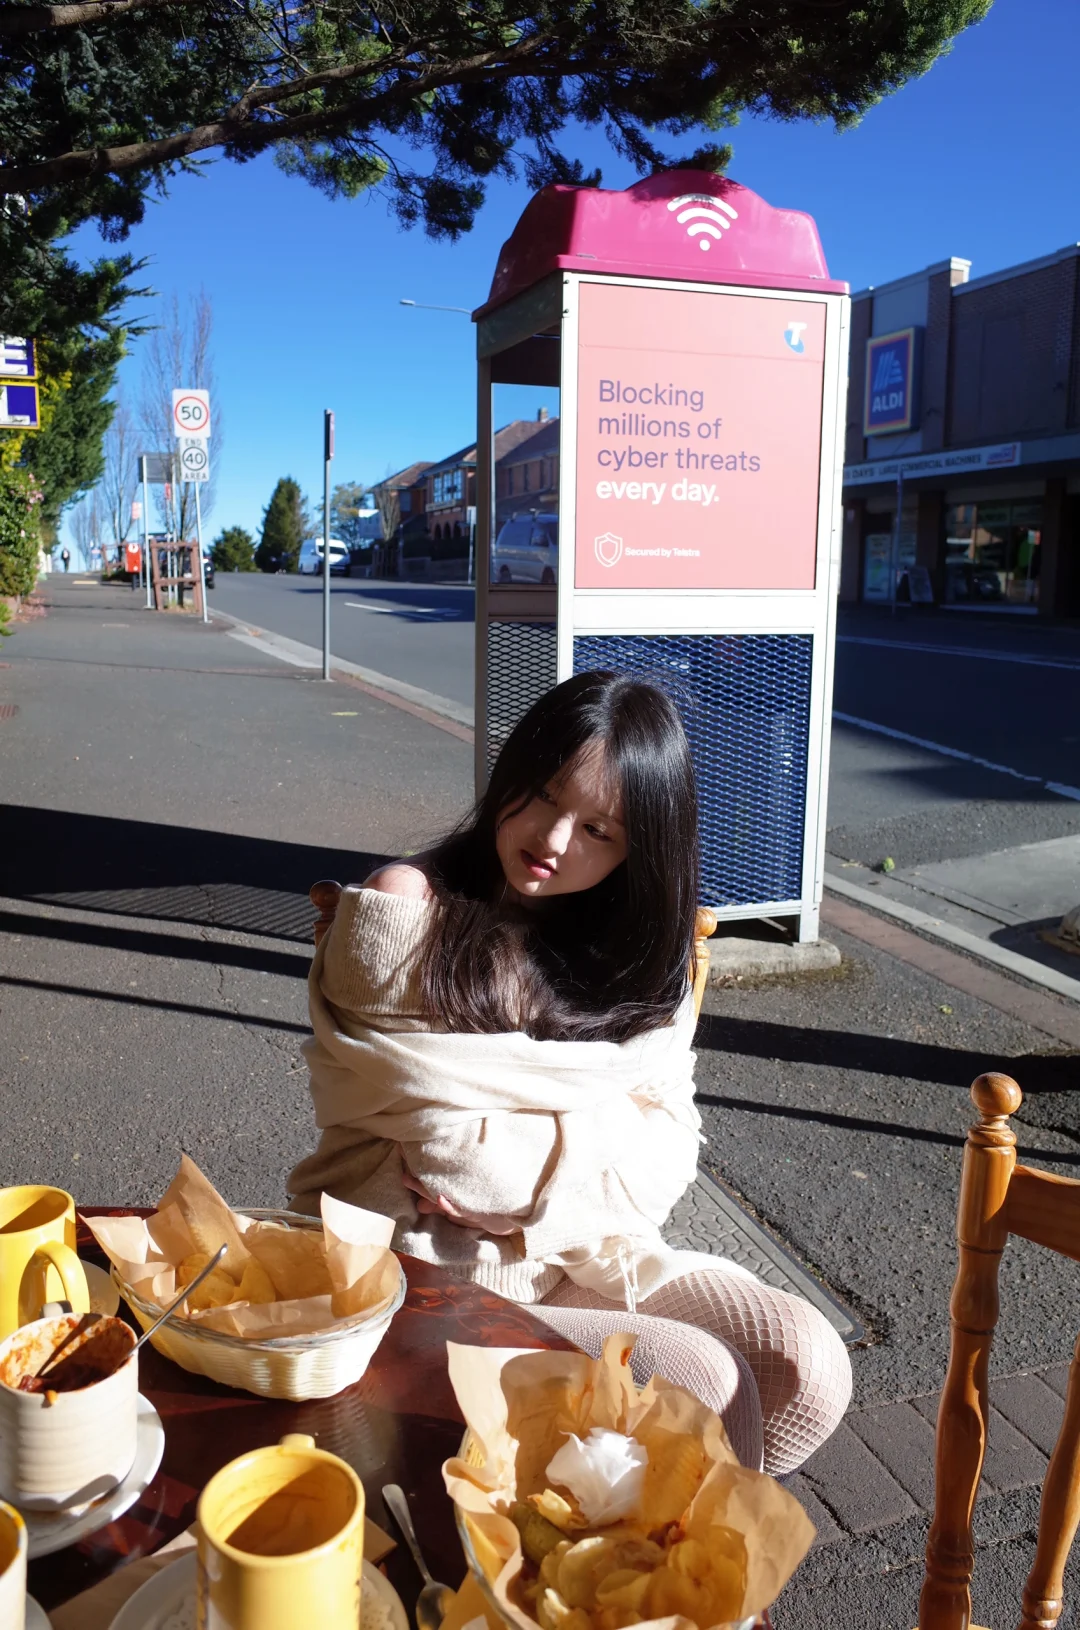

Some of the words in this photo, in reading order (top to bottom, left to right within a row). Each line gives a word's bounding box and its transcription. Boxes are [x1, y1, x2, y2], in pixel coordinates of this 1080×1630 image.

[599, 379, 704, 412] Blocking
[872, 391, 904, 413] ALDI
[181, 405, 202, 421] 50
[598, 412, 691, 438] millions
[697, 418, 722, 439] of
[185, 453, 204, 465] 40
[597, 445, 669, 471] cyber
[675, 448, 761, 472] threats
[184, 472, 207, 480] AREA
[596, 479, 666, 505] every
[671, 477, 720, 507] day.
[625, 547, 660, 557] Secured
[661, 548, 672, 558] by
[673, 548, 700, 557] Telstra
